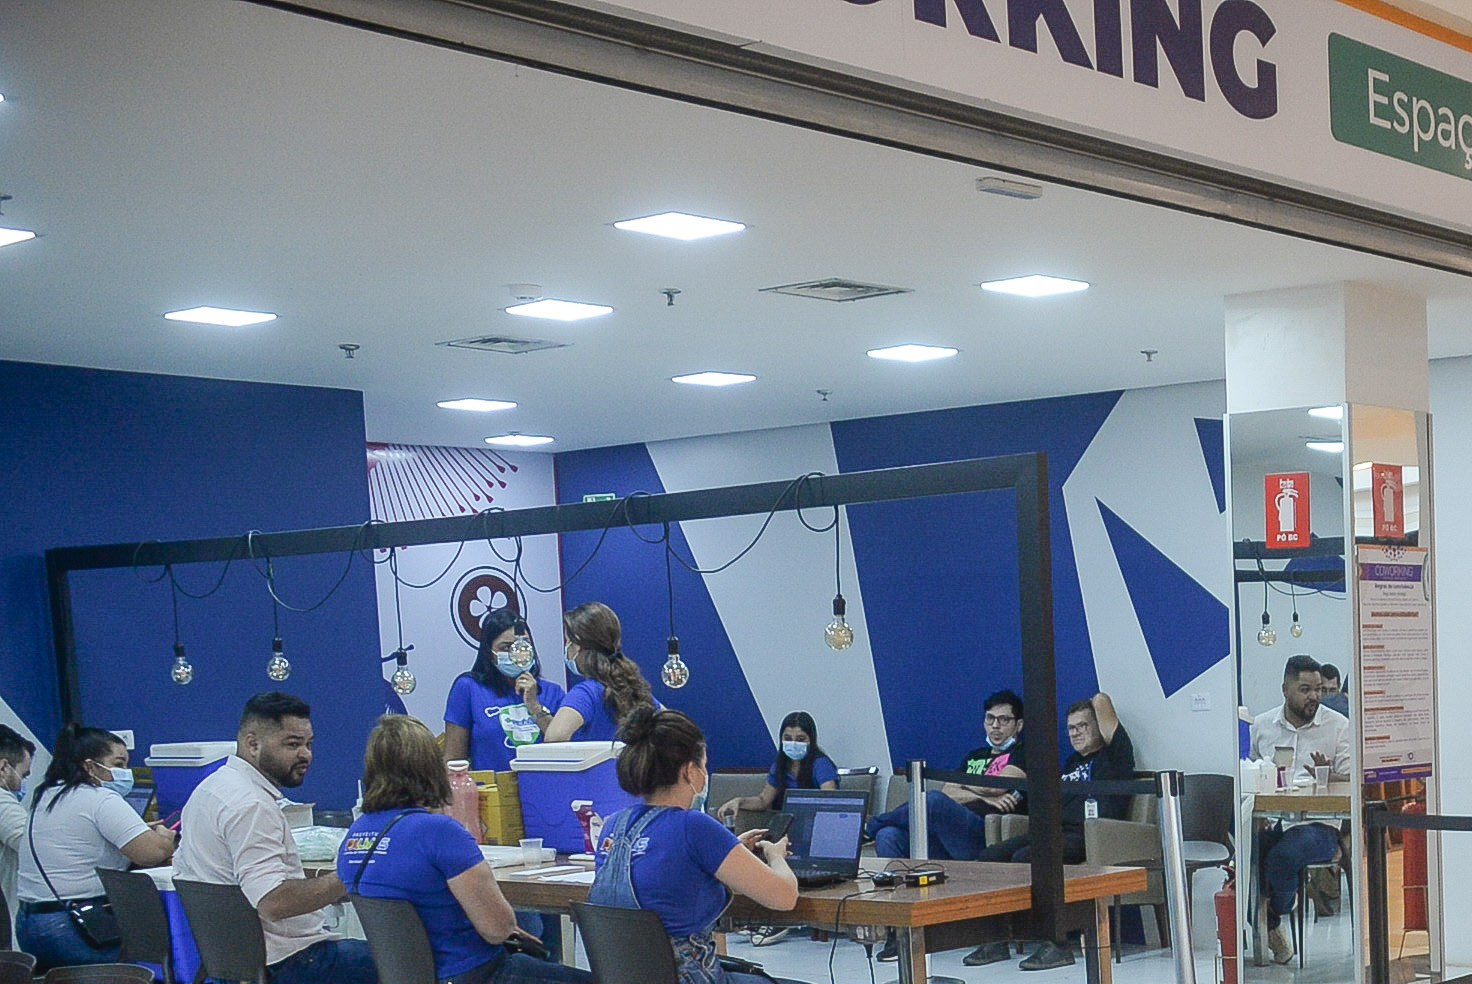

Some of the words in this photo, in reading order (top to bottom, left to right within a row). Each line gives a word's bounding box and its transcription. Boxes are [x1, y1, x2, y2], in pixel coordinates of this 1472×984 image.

[1276, 532, 1286, 542] PÓ
[1288, 533, 1298, 541] BC
[1374, 564, 1414, 577] COWORKING
